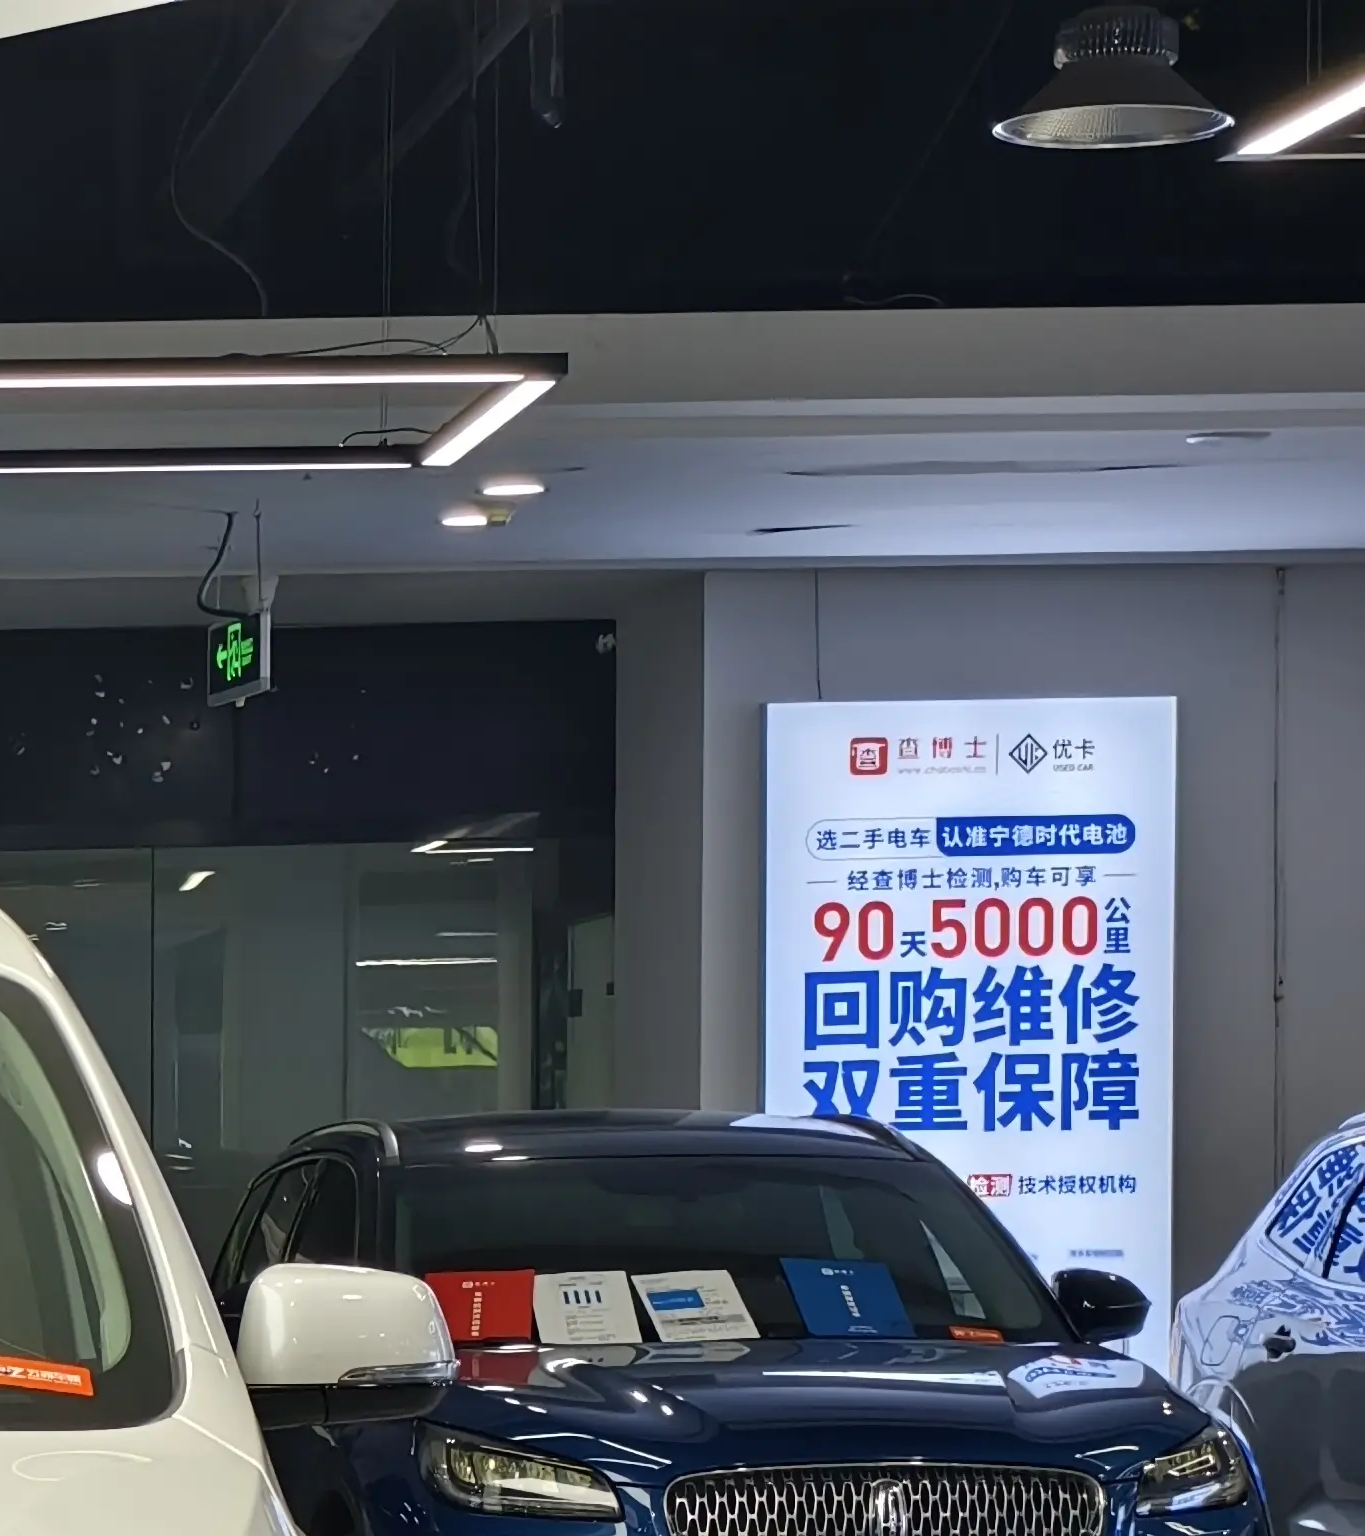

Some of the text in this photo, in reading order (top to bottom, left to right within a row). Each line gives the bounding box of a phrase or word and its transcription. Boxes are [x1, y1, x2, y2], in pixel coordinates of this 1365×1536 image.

[1052, 738, 1096, 760] 优卡
[816, 823, 1128, 851] 选二手电车 认准宁德时代电池
[804, 963, 1140, 1051] 回购维修
[803, 1047, 1140, 1132] 双重保障
[1018, 1174, 1137, 1195] 技术授权机构
